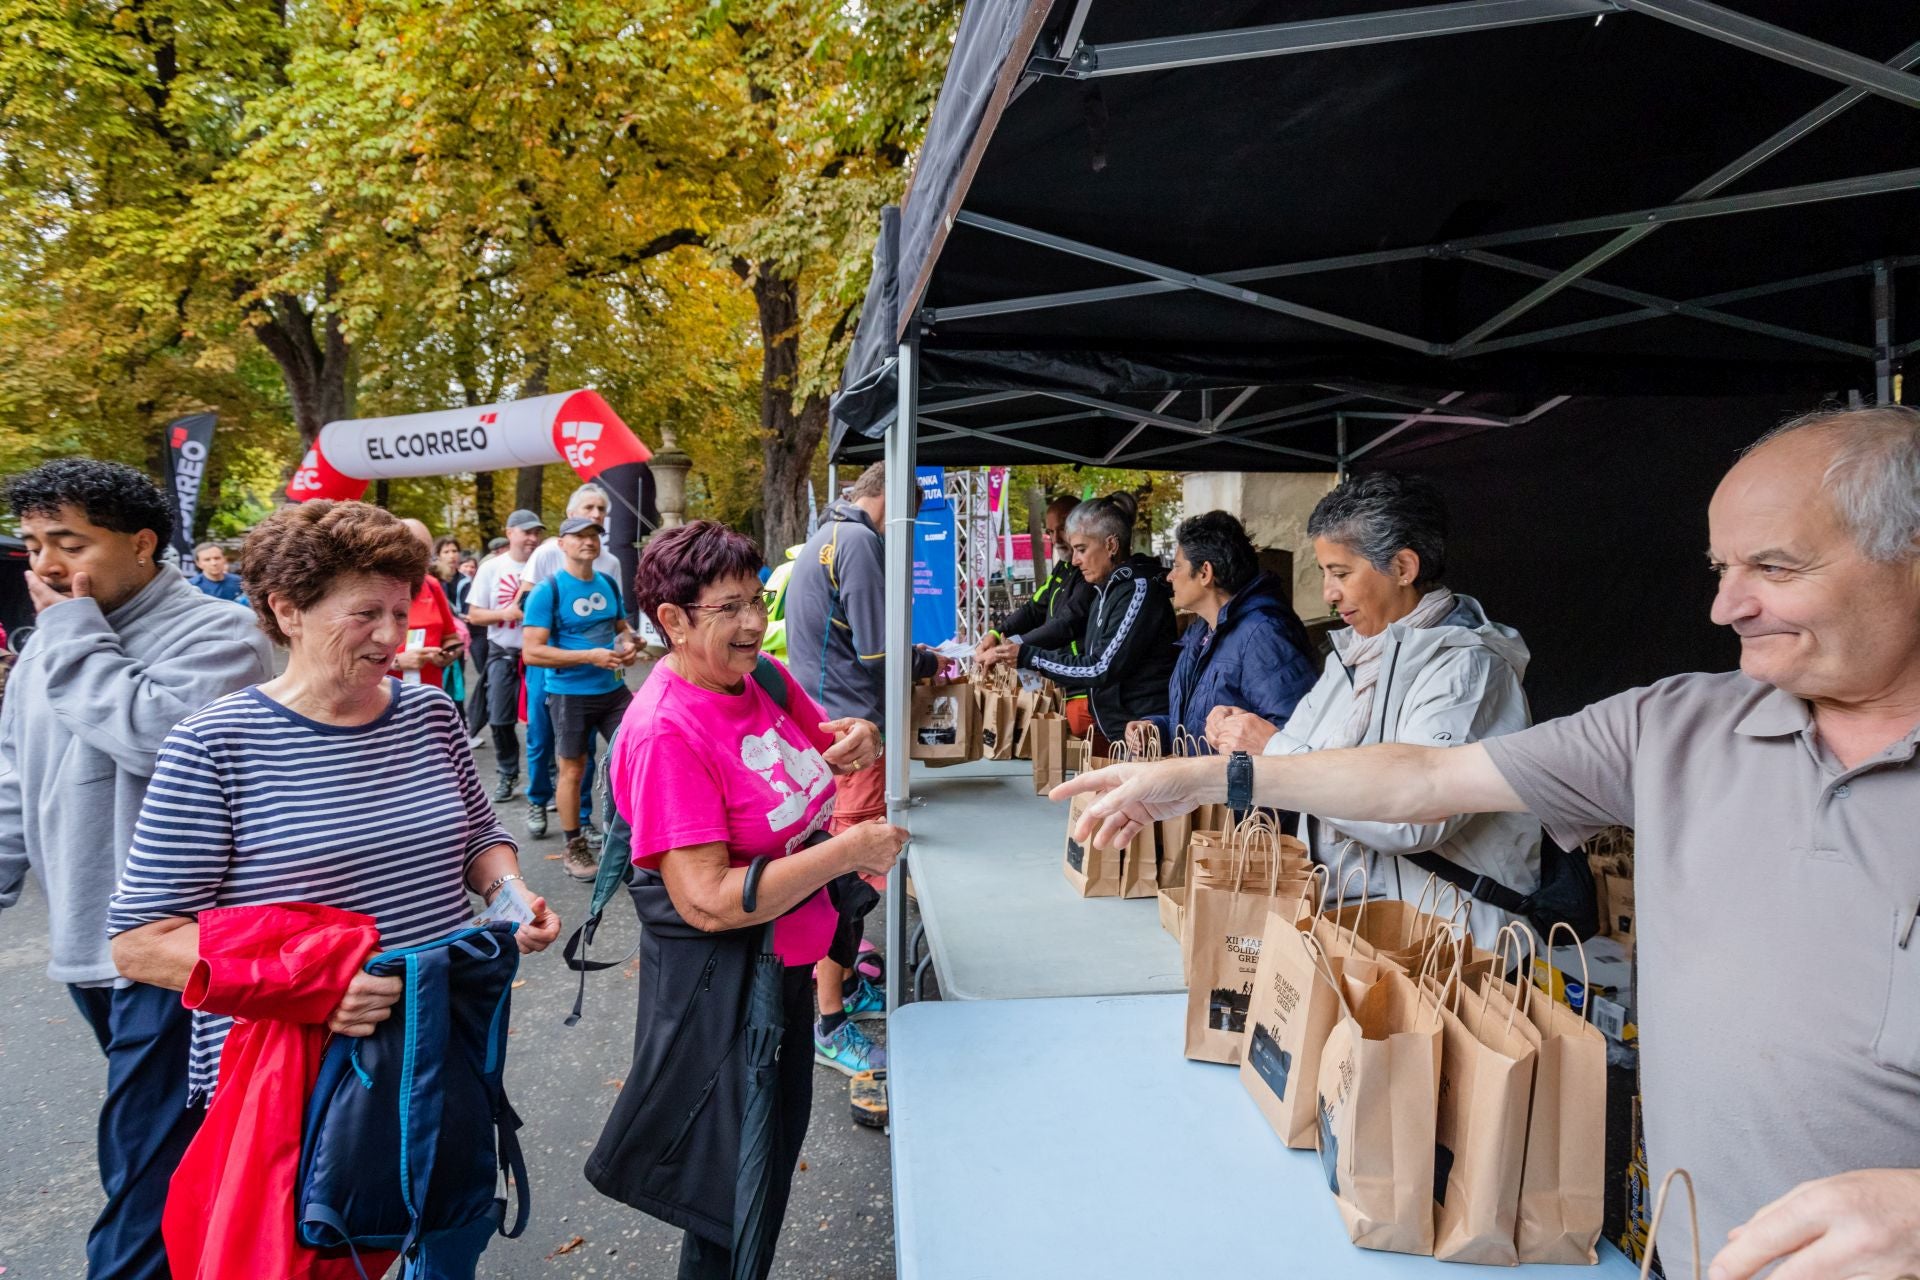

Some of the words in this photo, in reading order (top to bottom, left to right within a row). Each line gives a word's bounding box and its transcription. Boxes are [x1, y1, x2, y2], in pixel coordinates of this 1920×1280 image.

[367, 437, 394, 460] EL
[395, 426, 488, 458] CORREO
[564, 442, 597, 468] EC
[292, 470, 322, 491] EC
[917, 475, 938, 486] ONKA
[924, 488, 942, 500] TUTA
[1225, 936, 1239, 944] XII
[1241, 938, 1263, 948] MAR
[1228, 945, 1261, 956] SOLIDA
[1238, 954, 1260, 964] GRE
